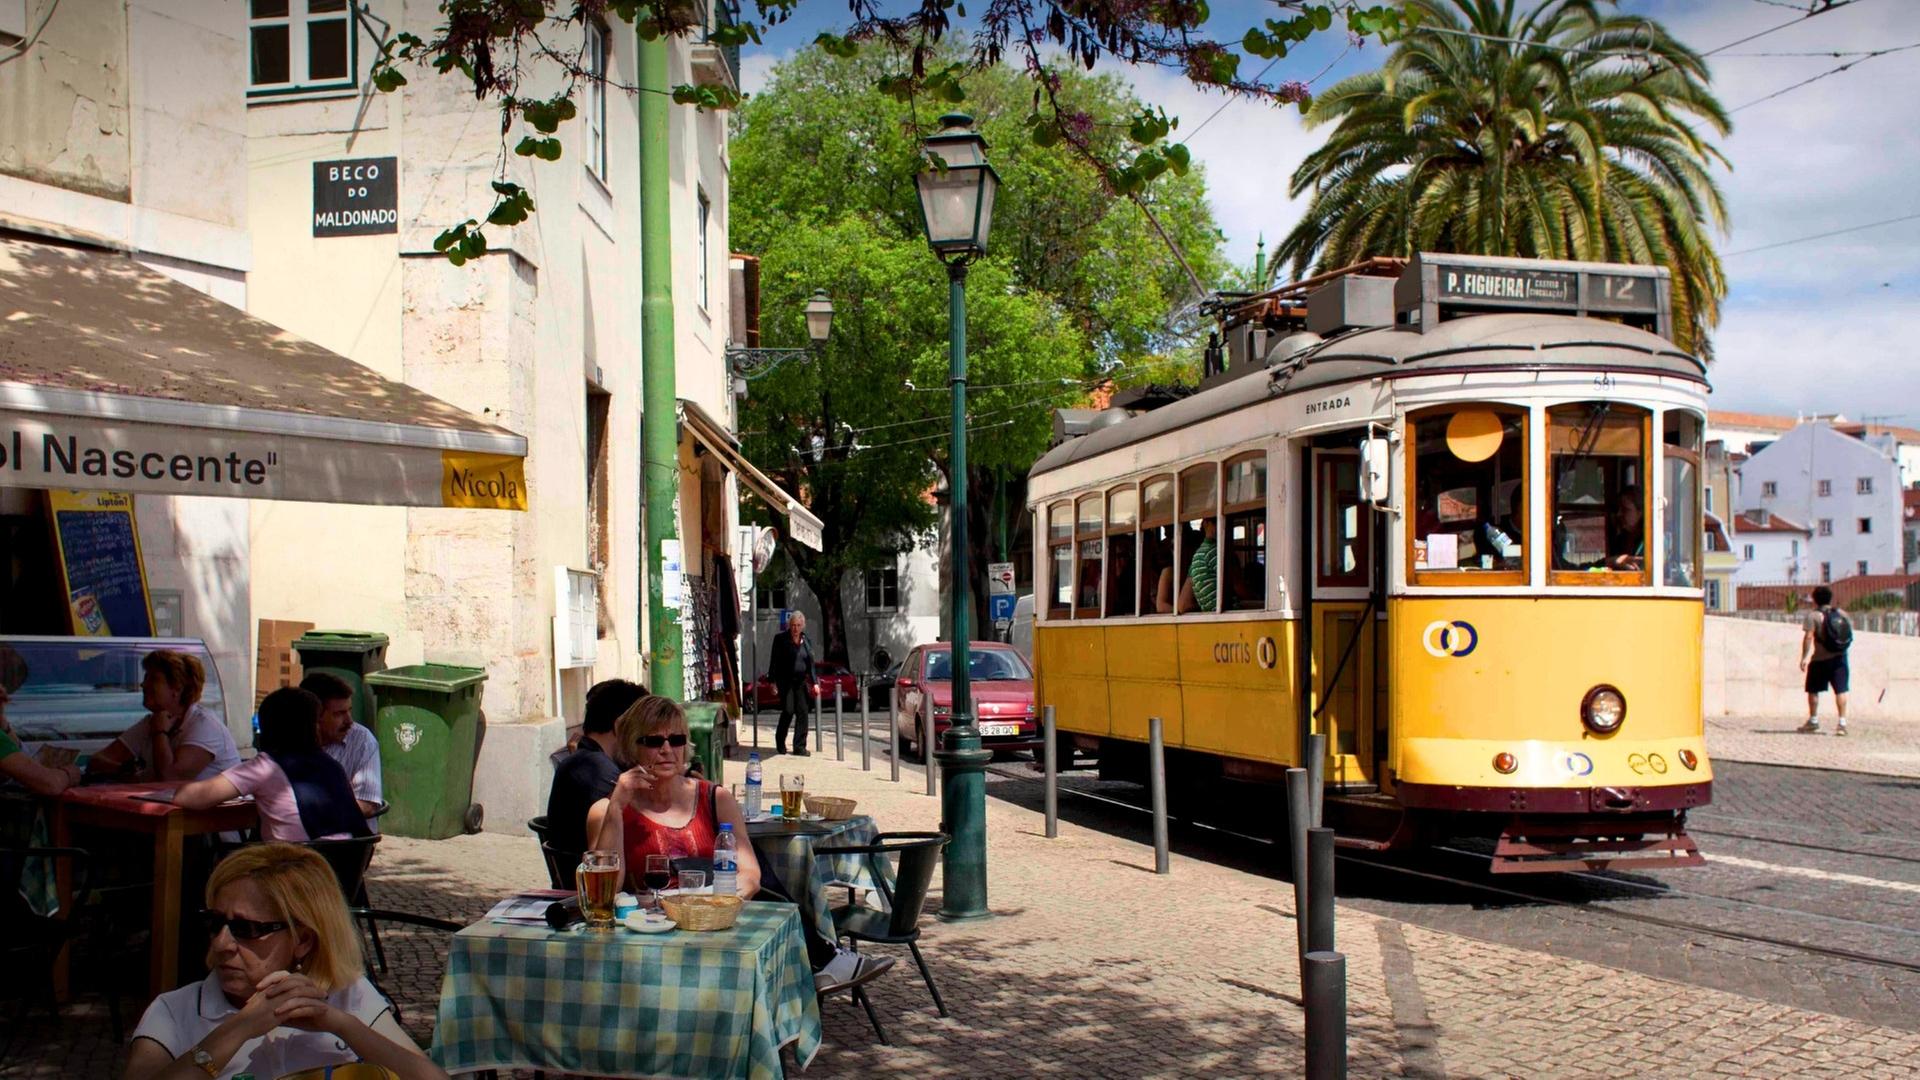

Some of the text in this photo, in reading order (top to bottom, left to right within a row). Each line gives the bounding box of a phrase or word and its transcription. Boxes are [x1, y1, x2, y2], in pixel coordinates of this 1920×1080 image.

[329, 165, 379, 181] BECO
[348, 187, 367, 197] DO
[315, 209, 397, 227] MALDONADO
[1447, 272, 1635, 300] P. FIGUEIRA 12
[1306, 397, 1351, 415] ENTRADA
[43, 433, 278, 485] Nascente"
[450, 467, 519, 499] Nicola
[996, 599, 1009, 617] P
[1213, 632, 1251, 664] carris
